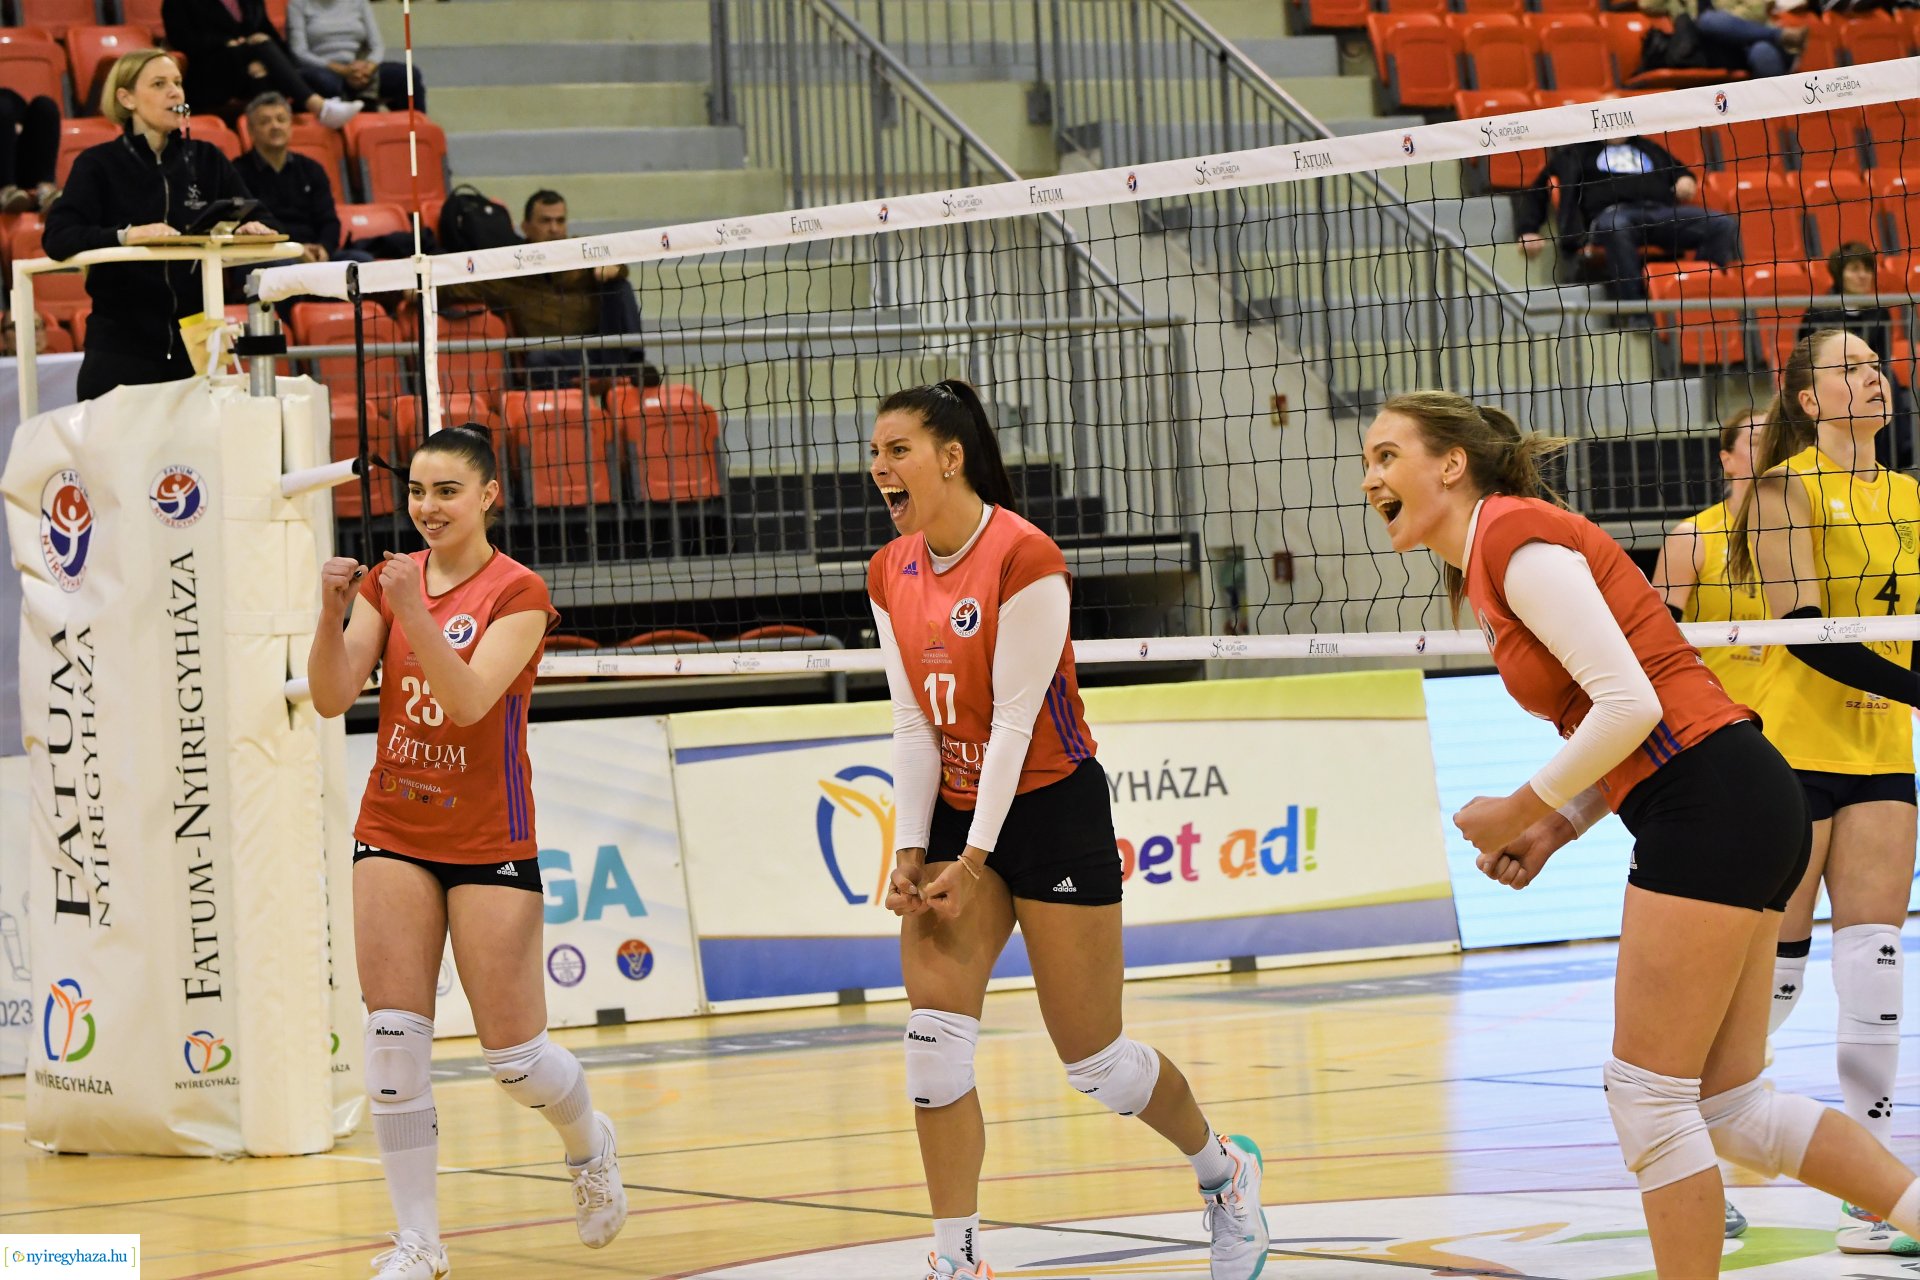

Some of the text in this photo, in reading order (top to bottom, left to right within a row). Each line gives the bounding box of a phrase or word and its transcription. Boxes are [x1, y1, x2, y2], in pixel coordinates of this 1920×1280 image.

[1590, 109, 1635, 130] FATUM
[1293, 151, 1333, 169] FATUM
[1029, 186, 1064, 204] FATUM
[790, 216, 823, 234] FATUM
[1874, 572, 1901, 616] 4
[1309, 639, 1339, 654] FATUM
[401, 675, 444, 727] 23
[924, 672, 957, 726] 17
[387, 723, 468, 766] FATUM
[48, 622, 92, 928] FATUM
[1218, 805, 1318, 879] ad!
[497, 869, 518, 877] adidas
[1053, 884, 1077, 893] adidas
[34, 1069, 113, 1095] NYÍREGYHÁZA
